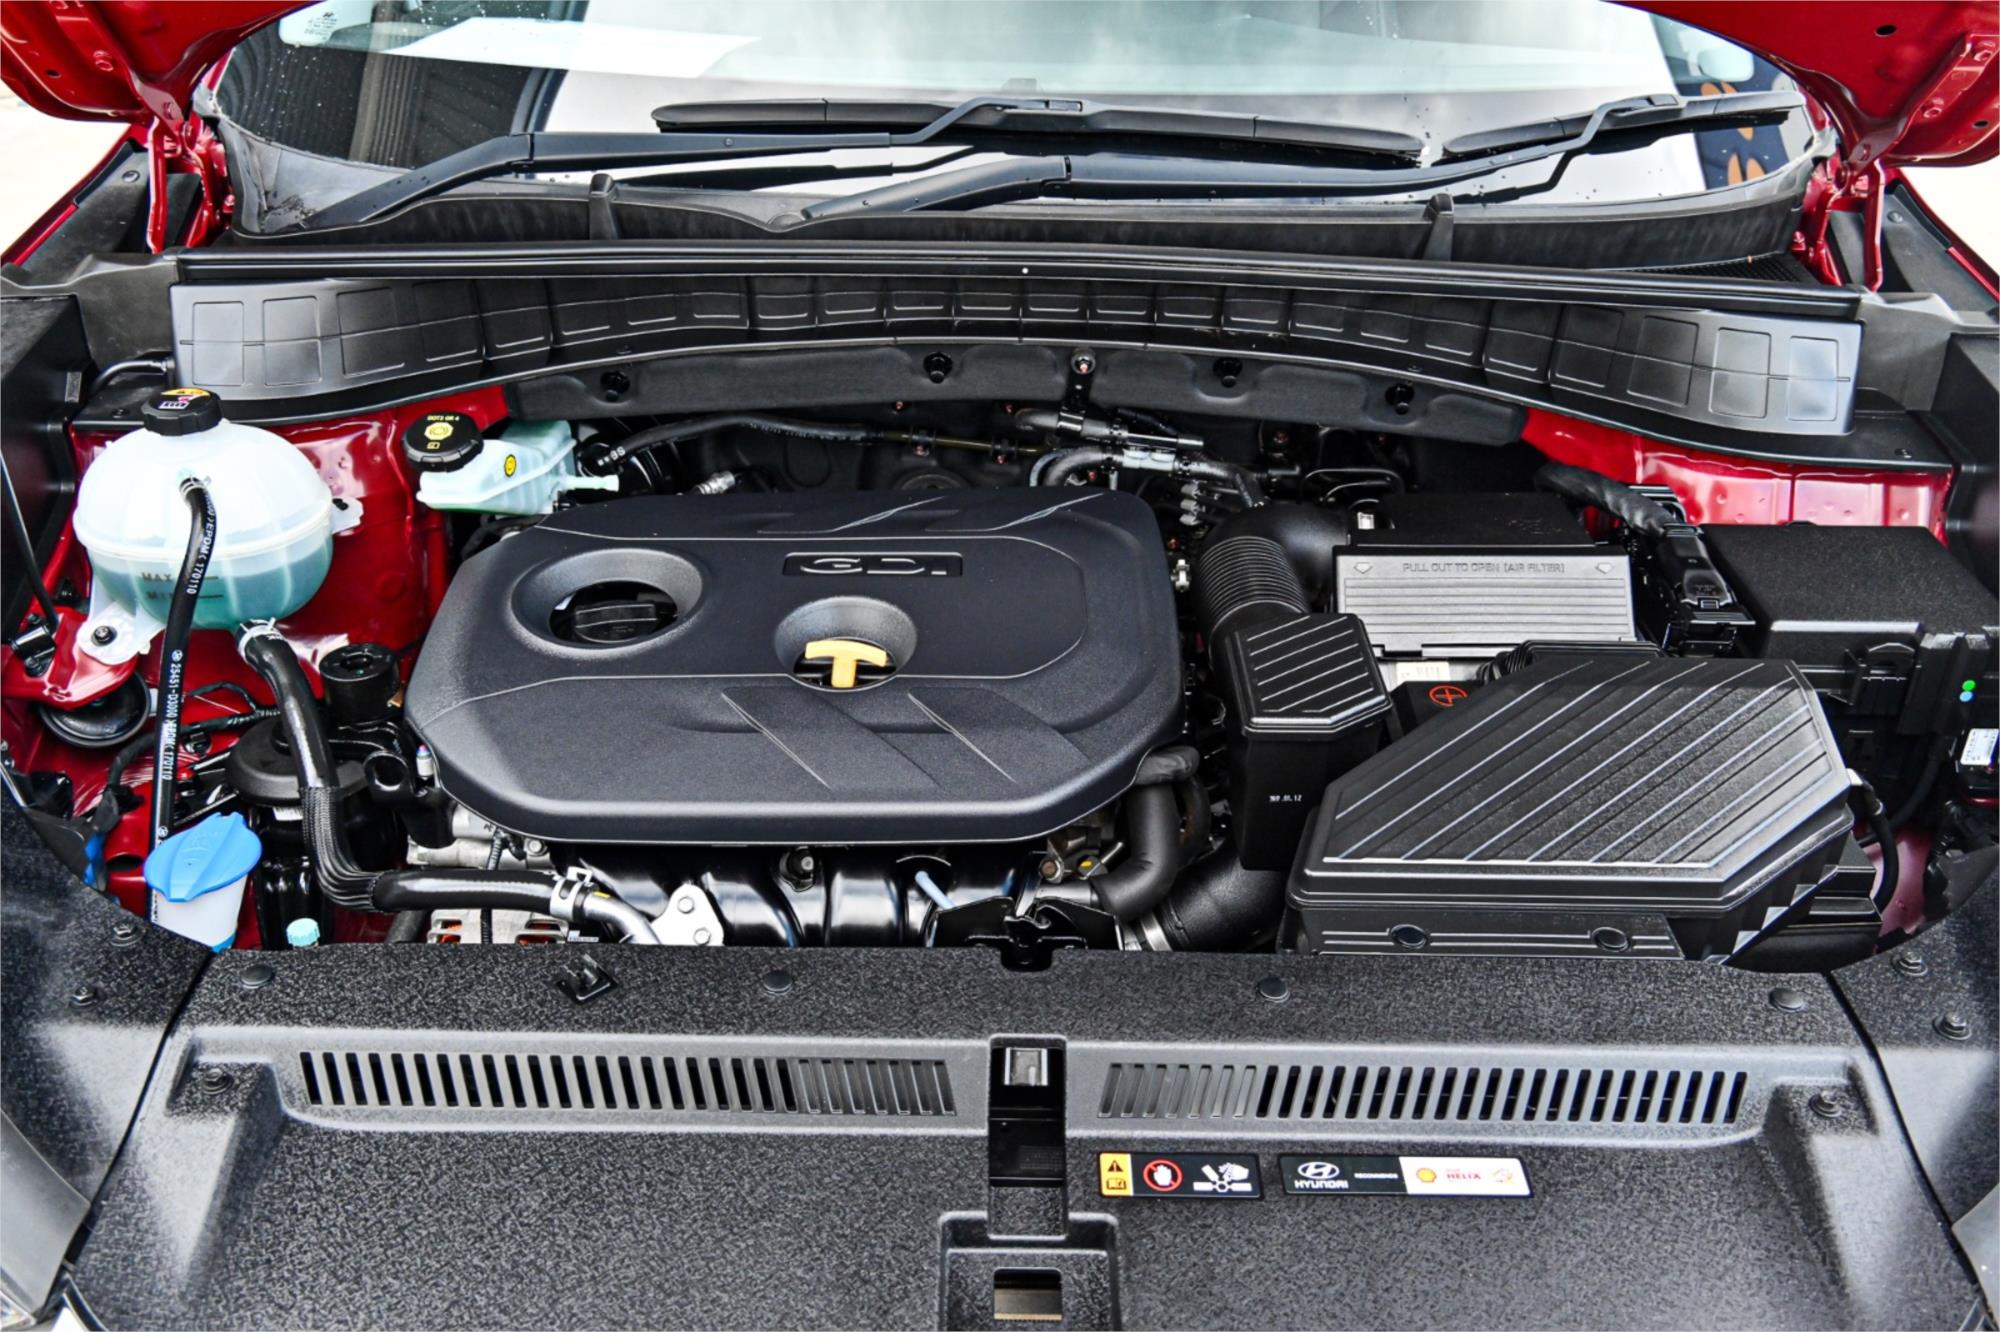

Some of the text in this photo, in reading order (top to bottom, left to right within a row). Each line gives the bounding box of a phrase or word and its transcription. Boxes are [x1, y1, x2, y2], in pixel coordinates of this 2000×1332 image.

[1403, 562, 1429, 573] PULL
[1432, 562, 1452, 573] OUT
[1455, 562, 1469, 573] TO
[1472, 562, 1500, 573] OPEN
[142, 572, 172, 582] MAX
